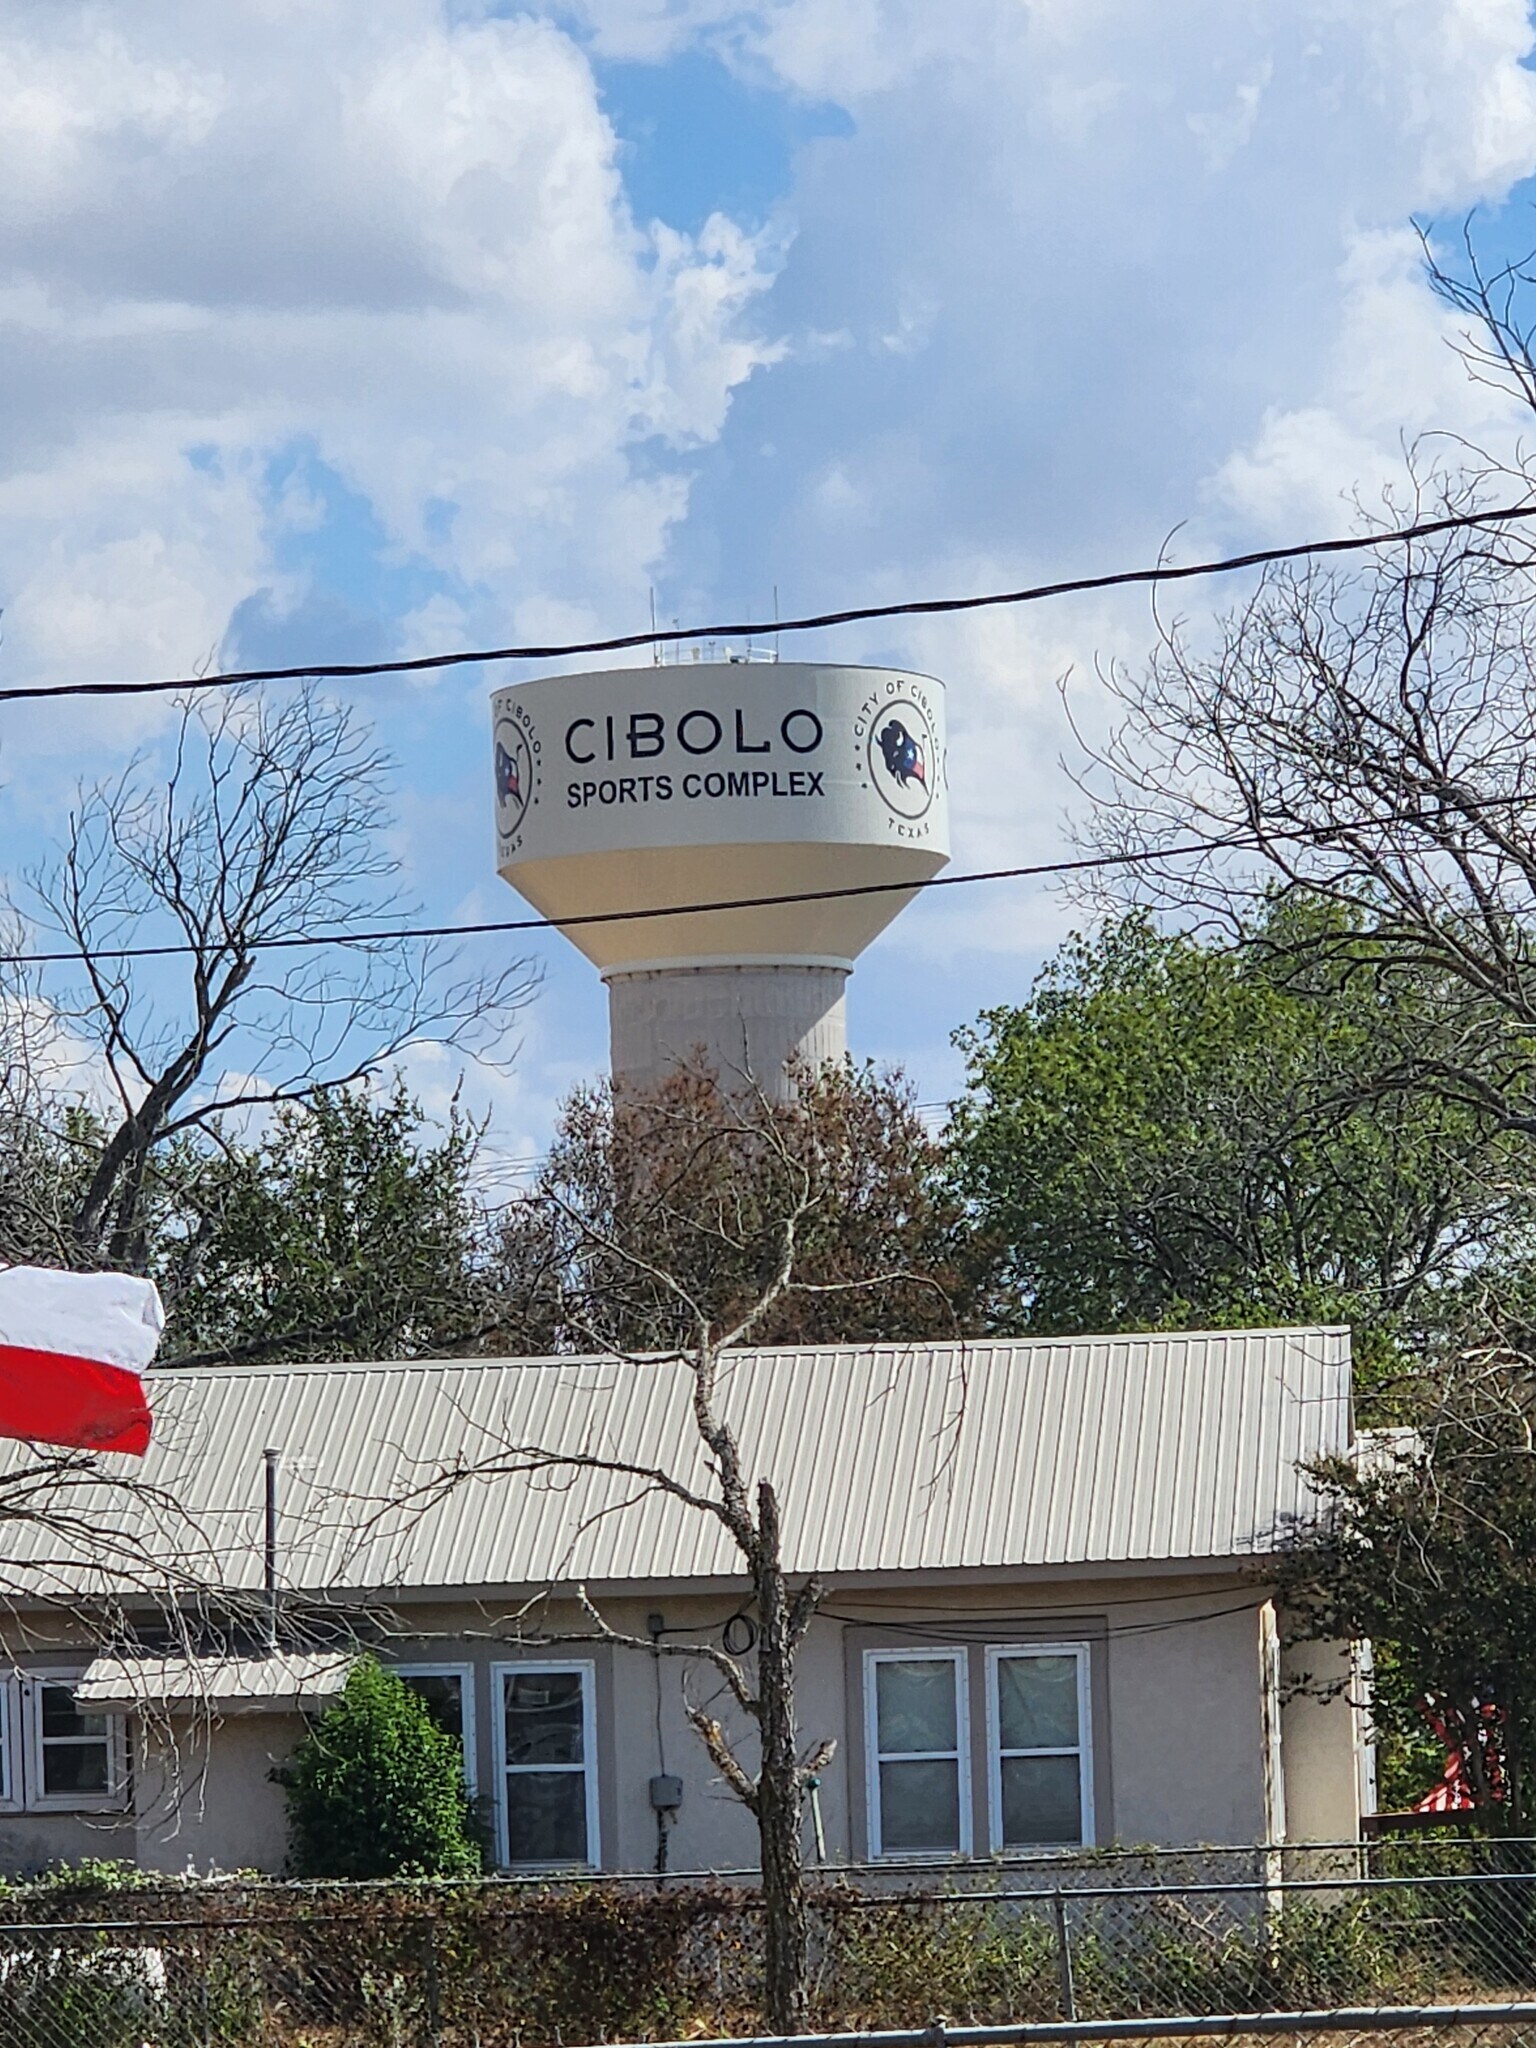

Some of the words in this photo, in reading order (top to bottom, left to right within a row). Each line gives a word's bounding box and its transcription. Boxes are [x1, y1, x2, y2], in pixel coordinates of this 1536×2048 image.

[506, 699, 541, 753] CIBOLO
[565, 708, 823, 764] CIBOLO
[854, 692, 879, 738] CITY
[886, 680, 905, 695] OF
[567, 775, 673, 808] SPORTS
[682, 771, 825, 798] COMPLEX
[888, 817, 930, 839] TEXAS
